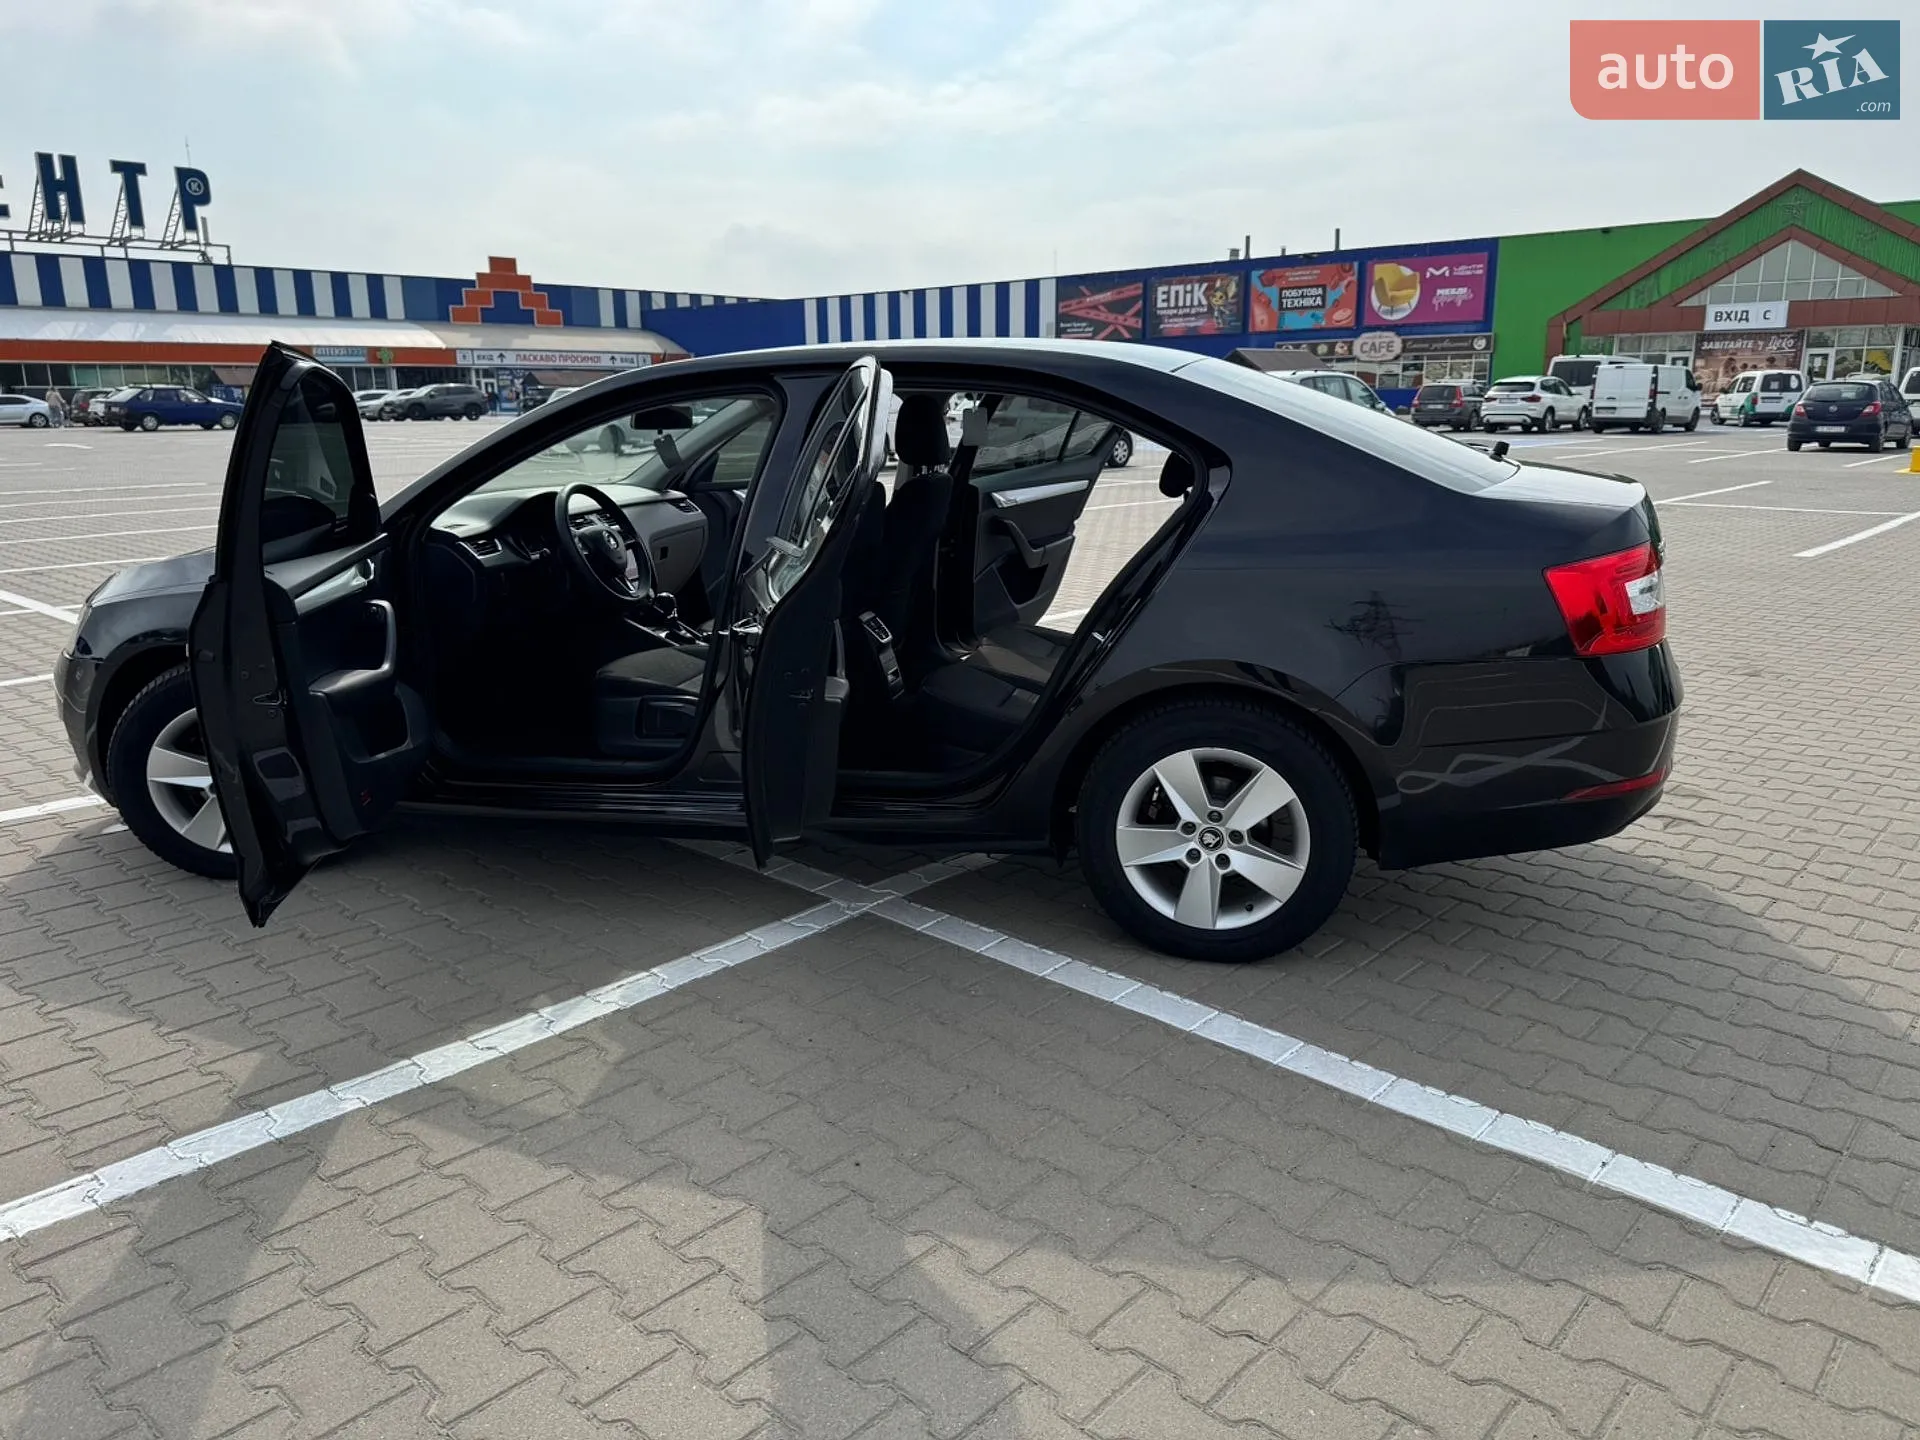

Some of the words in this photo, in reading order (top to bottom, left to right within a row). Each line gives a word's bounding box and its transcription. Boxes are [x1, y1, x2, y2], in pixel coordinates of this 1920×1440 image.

[1281, 287, 1323, 298] ПОБУТОВА
[1281, 296, 1323, 309] ТЕХНІКА
[1713, 309, 1750, 323] ВХІД
[1360, 340, 1396, 354] CAFE
[1701, 338, 1754, 350] ЗАВІТАЙТЕ
[515, 353, 557, 363] ЛАСКАВО
